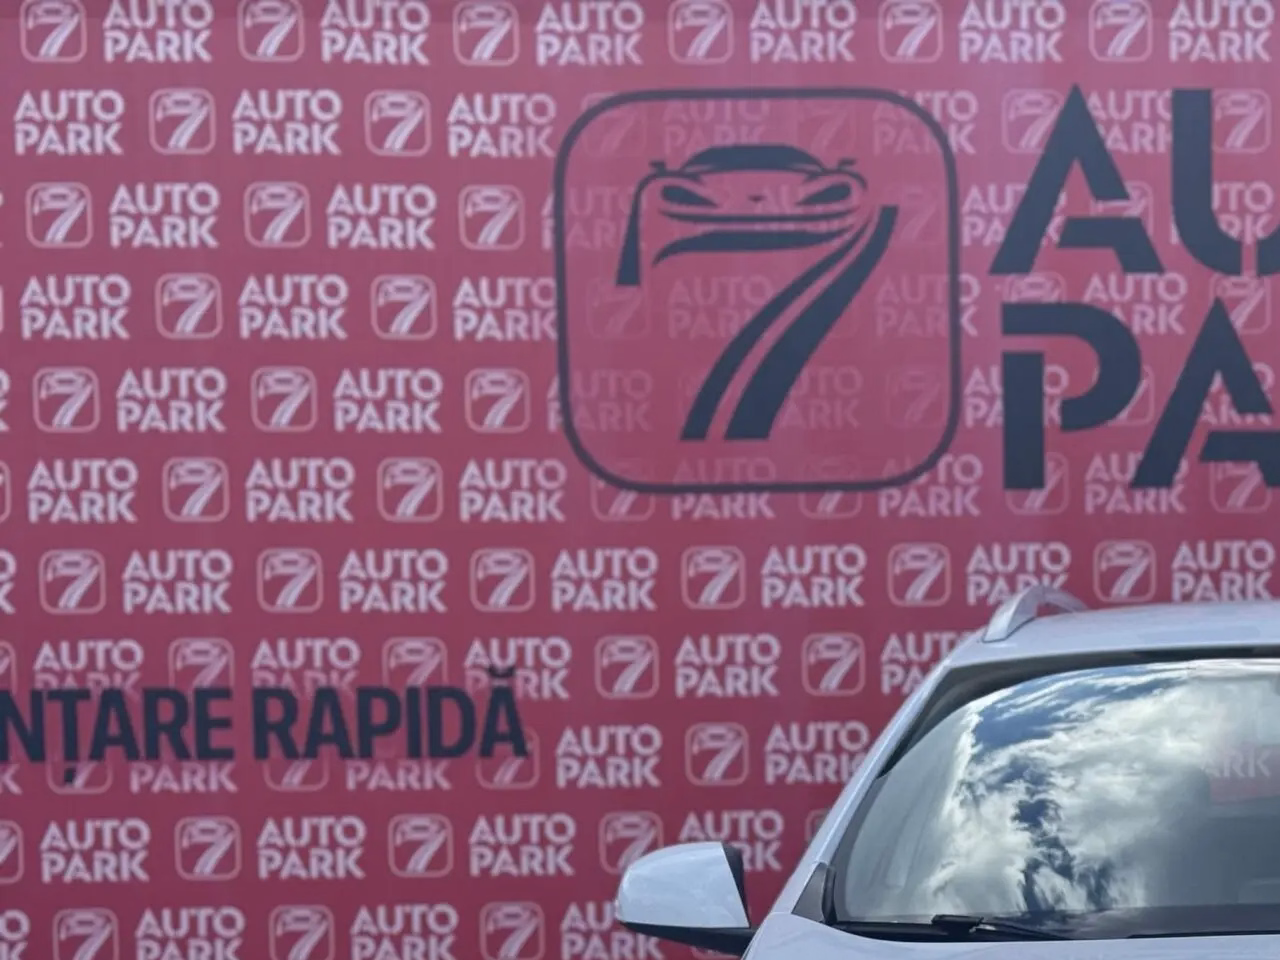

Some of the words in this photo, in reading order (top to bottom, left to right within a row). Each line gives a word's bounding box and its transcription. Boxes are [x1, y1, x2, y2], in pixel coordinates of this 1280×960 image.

[535, 0, 643, 32] AUTO
[536, 33, 641, 66] PARK
[14, 89, 124, 122] AUTO
[232, 89, 342, 122] AUTO
[447, 93, 556, 124] AUTO
[15, 121, 122, 154] PARK
[234, 121, 340, 154] PARK
[448, 125, 553, 157] PARK
[110, 183, 219, 215] AUTO
[327, 184, 437, 217] AUTO
[110, 215, 218, 247] PARK
[328, 216, 434, 249] PARK
[21, 274, 131, 307] AUTO
[239, 274, 348, 307] AUTO
[453, 277, 555, 308] AUTO
[22, 306, 129, 339] PARK
[240, 306, 347, 339] PARK
[454, 308, 556, 341] PARK
[116, 367, 226, 400] AUTO
[334, 368, 443, 400] AUTO
[117, 399, 225, 432] PARK
[335, 399, 440, 432] PARK
[28, 458, 138, 490] AUTO
[246, 458, 355, 490] AUTO
[459, 459, 566, 489] AUTO
[29, 491, 136, 523] PARK
[246, 489, 353, 521] PARK
[460, 490, 564, 522] PARK
[123, 549, 233, 581] AUTO
[339, 549, 448, 581] AUTO
[551, 548, 658, 579] AUTO
[761, 544, 866, 575] AUTO
[124, 581, 230, 613] PARK
[340, 580, 446, 612] PARK
[552, 580, 655, 611] PARK
[762, 576, 863, 608] PARK
[675, 633, 781, 665] AUTO
[676, 666, 778, 697] PARK
[252, 664, 528, 761] RAPIDĂ
[556, 725, 662, 756] AUTO
[557, 757, 659, 788] PARK
[40, 818, 150, 850] AUTO
[257, 816, 366, 847] AUTO
[469, 813, 576, 844] AUTO
[42, 851, 148, 883] PARK
[258, 848, 364, 879] PARK
[470, 845, 573, 876] PARK
[135, 906, 245, 938] AUTO
[350, 903, 458, 934] AUTO
